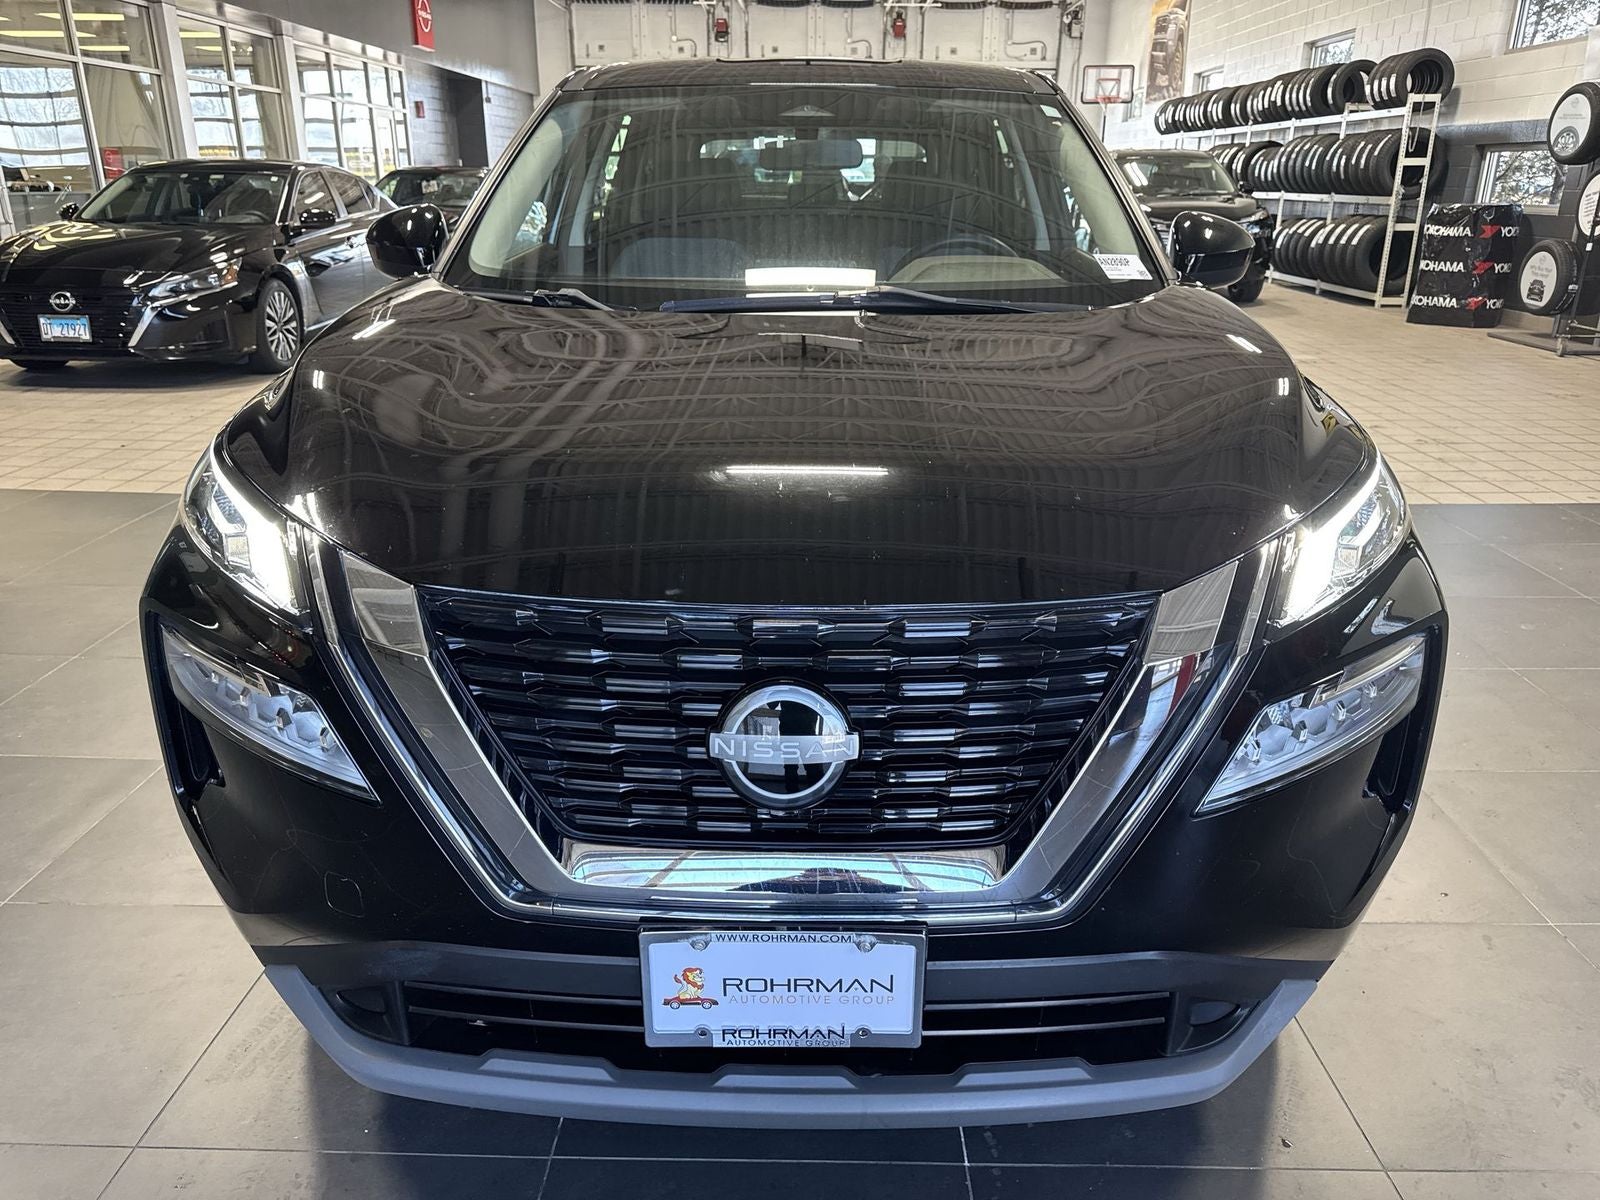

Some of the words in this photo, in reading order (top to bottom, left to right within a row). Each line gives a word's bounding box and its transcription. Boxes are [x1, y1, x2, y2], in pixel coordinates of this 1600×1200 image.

[60, 322, 87, 336] 27927
[714, 737, 854, 758] NISSAN
[715, 933, 852, 944] WWW.ROHRMAN.COM
[722, 974, 894, 997] ROHRMAN
[728, 995, 831, 1005] AUTOMOTIVE
[838, 995, 895, 1005] GROUP
[721, 1025, 846, 1043] ROHRMAN
[726, 1039, 800, 1047] AUTOMOTIVE
[805, 1039, 846, 1048] GROUP
